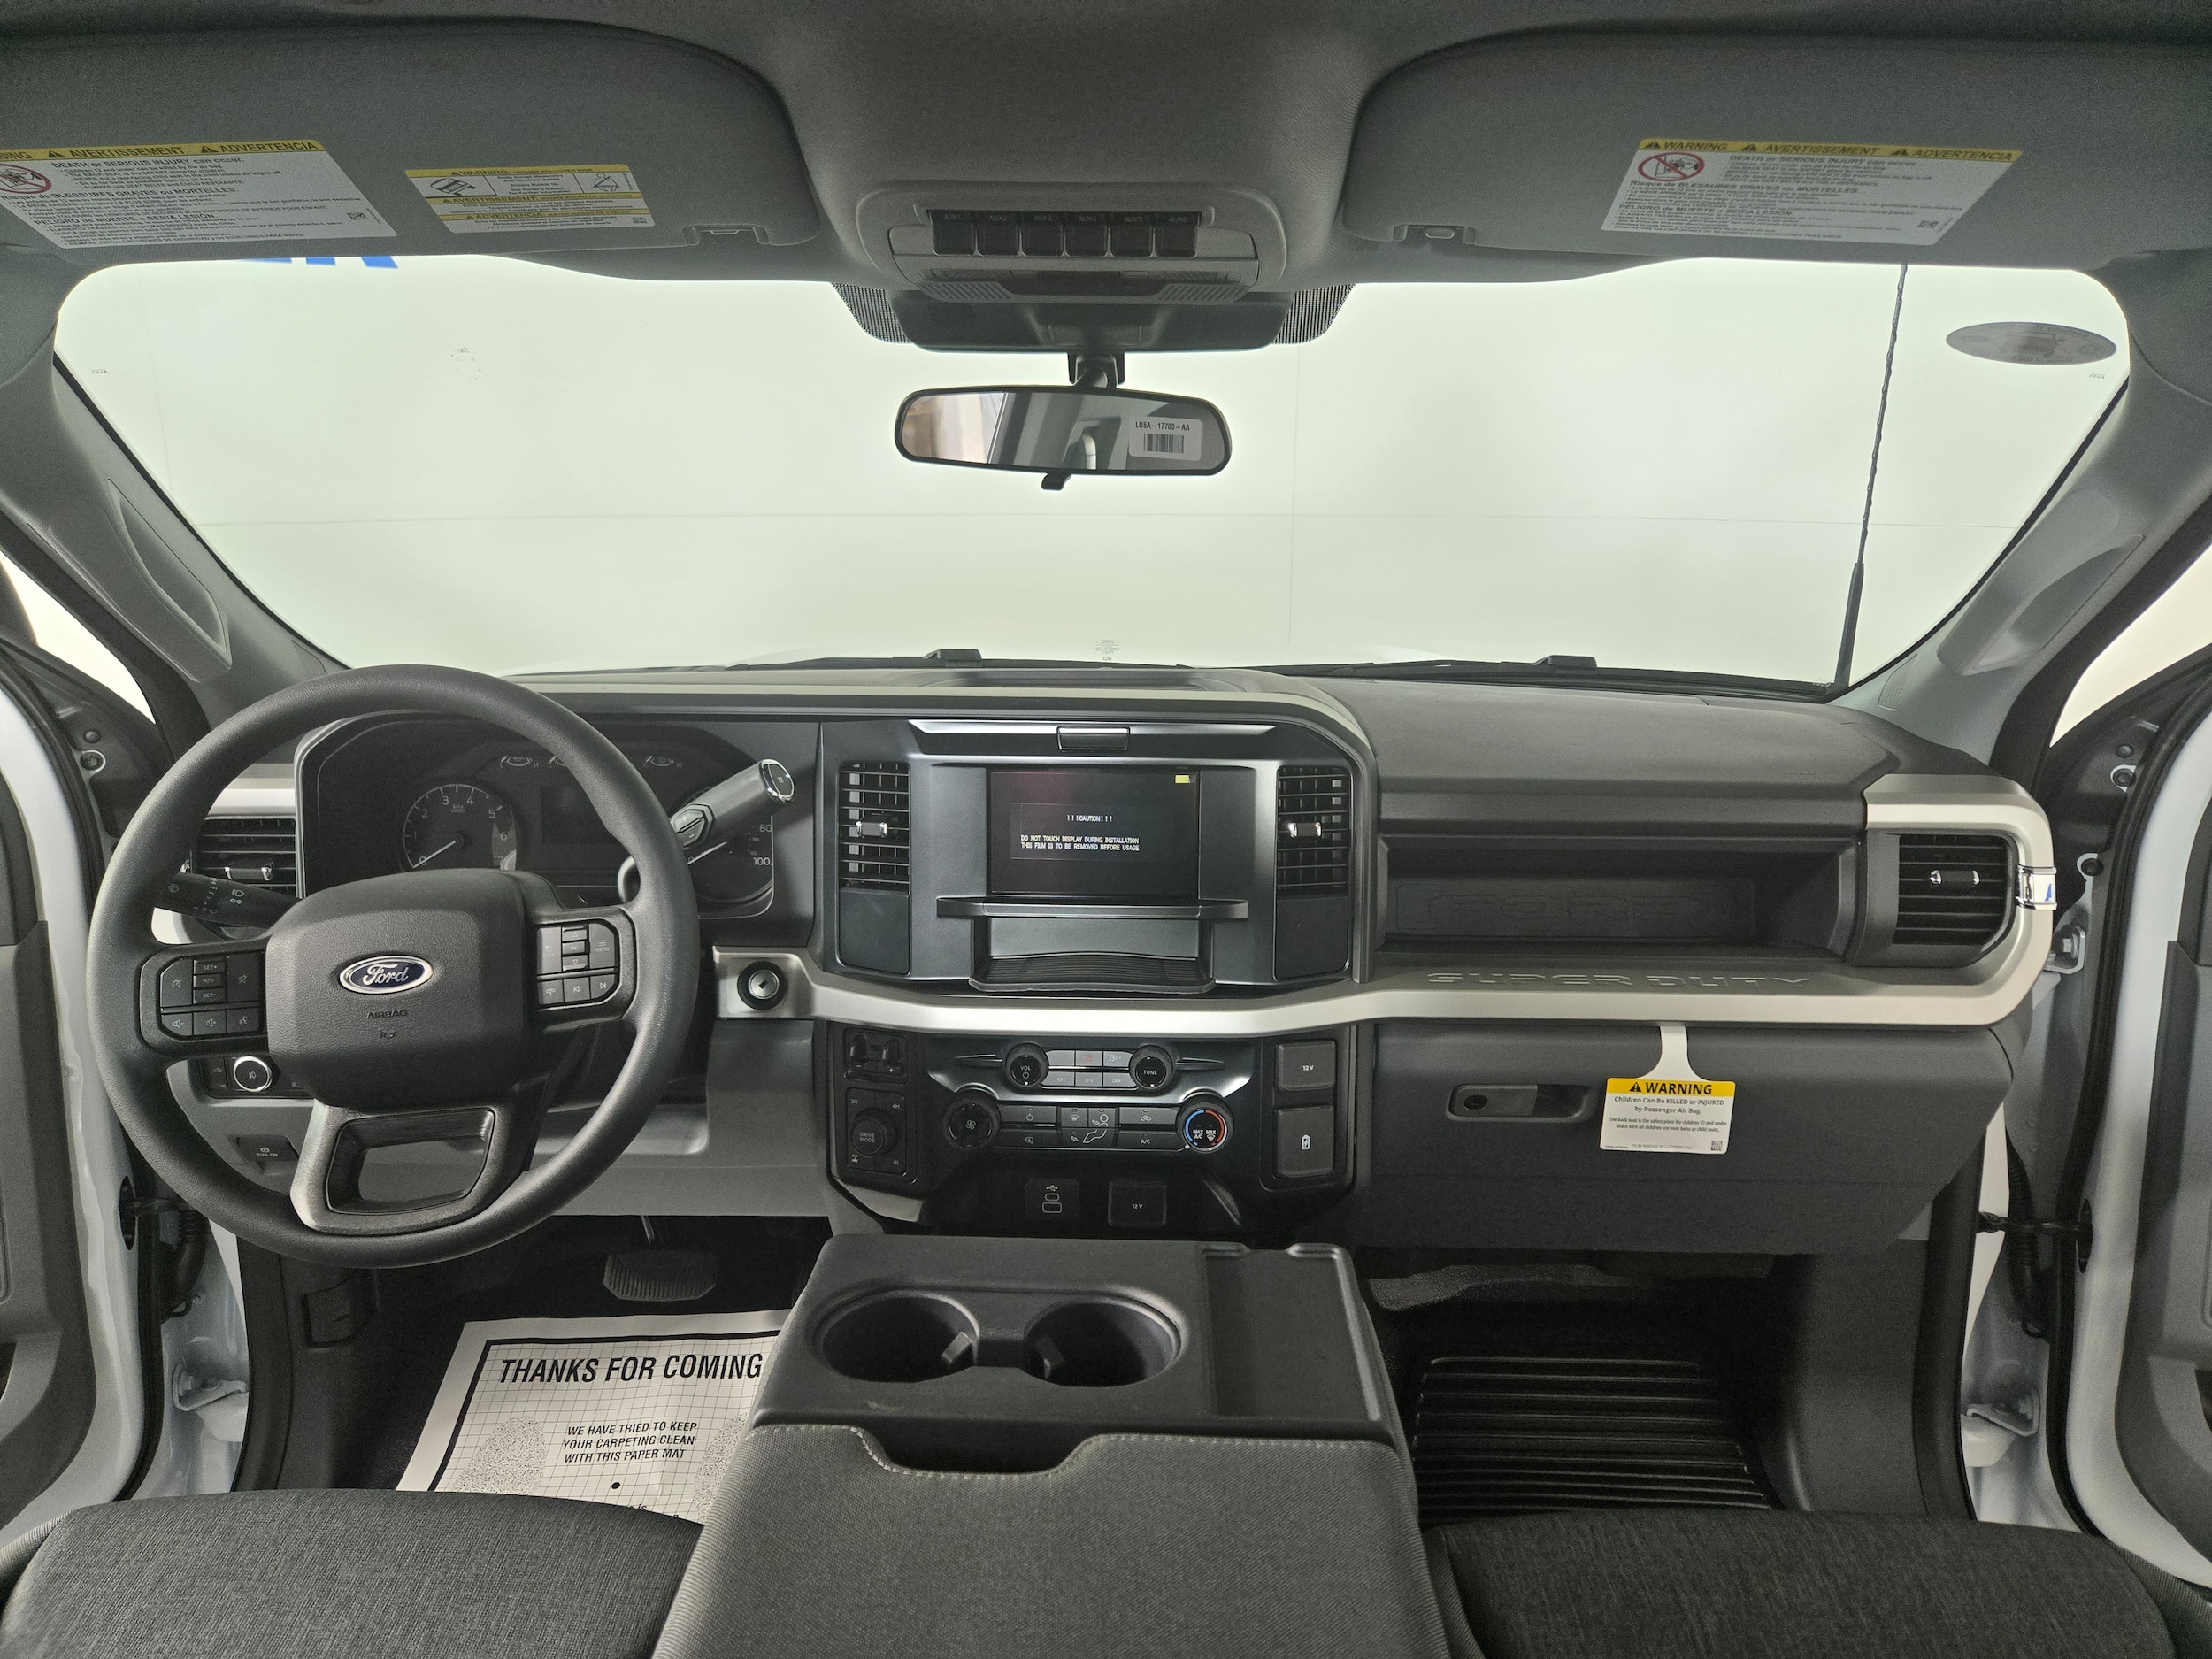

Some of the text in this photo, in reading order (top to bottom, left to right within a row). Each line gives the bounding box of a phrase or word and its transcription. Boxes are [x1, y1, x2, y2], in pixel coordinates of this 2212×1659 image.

[70, 147, 184, 157] AVERTISSEMENT
[220, 142, 319, 152] ADVERTENCIA
[1664, 142, 2013, 160] WARNING AVERTISSEMENT ADVERTENCIA
[442, 795, 449, 806] 3
[466, 795, 474, 805] 4
[421, 809, 428, 818] 2
[488, 809, 496, 818] 5
[759, 824, 772, 833] 80
[500, 832, 508, 841] 6
[753, 857, 771, 866] 100
[363, 963, 409, 986] Ford
[1427, 972, 1810, 988] SUPER DUTY
[366, 1010, 407, 1018] AIRBAG
[1646, 1082, 1712, 1094] WARNING
[500, 1353, 763, 1383] THANKS FOR COMING
[567, 1421, 697, 1435] WE HAVE TRIED TO KEEP
[562, 1434, 695, 1449] YOUR CARPETING CLEAN
[564, 1448, 687, 1463] WITH THIS PAPER MAT
